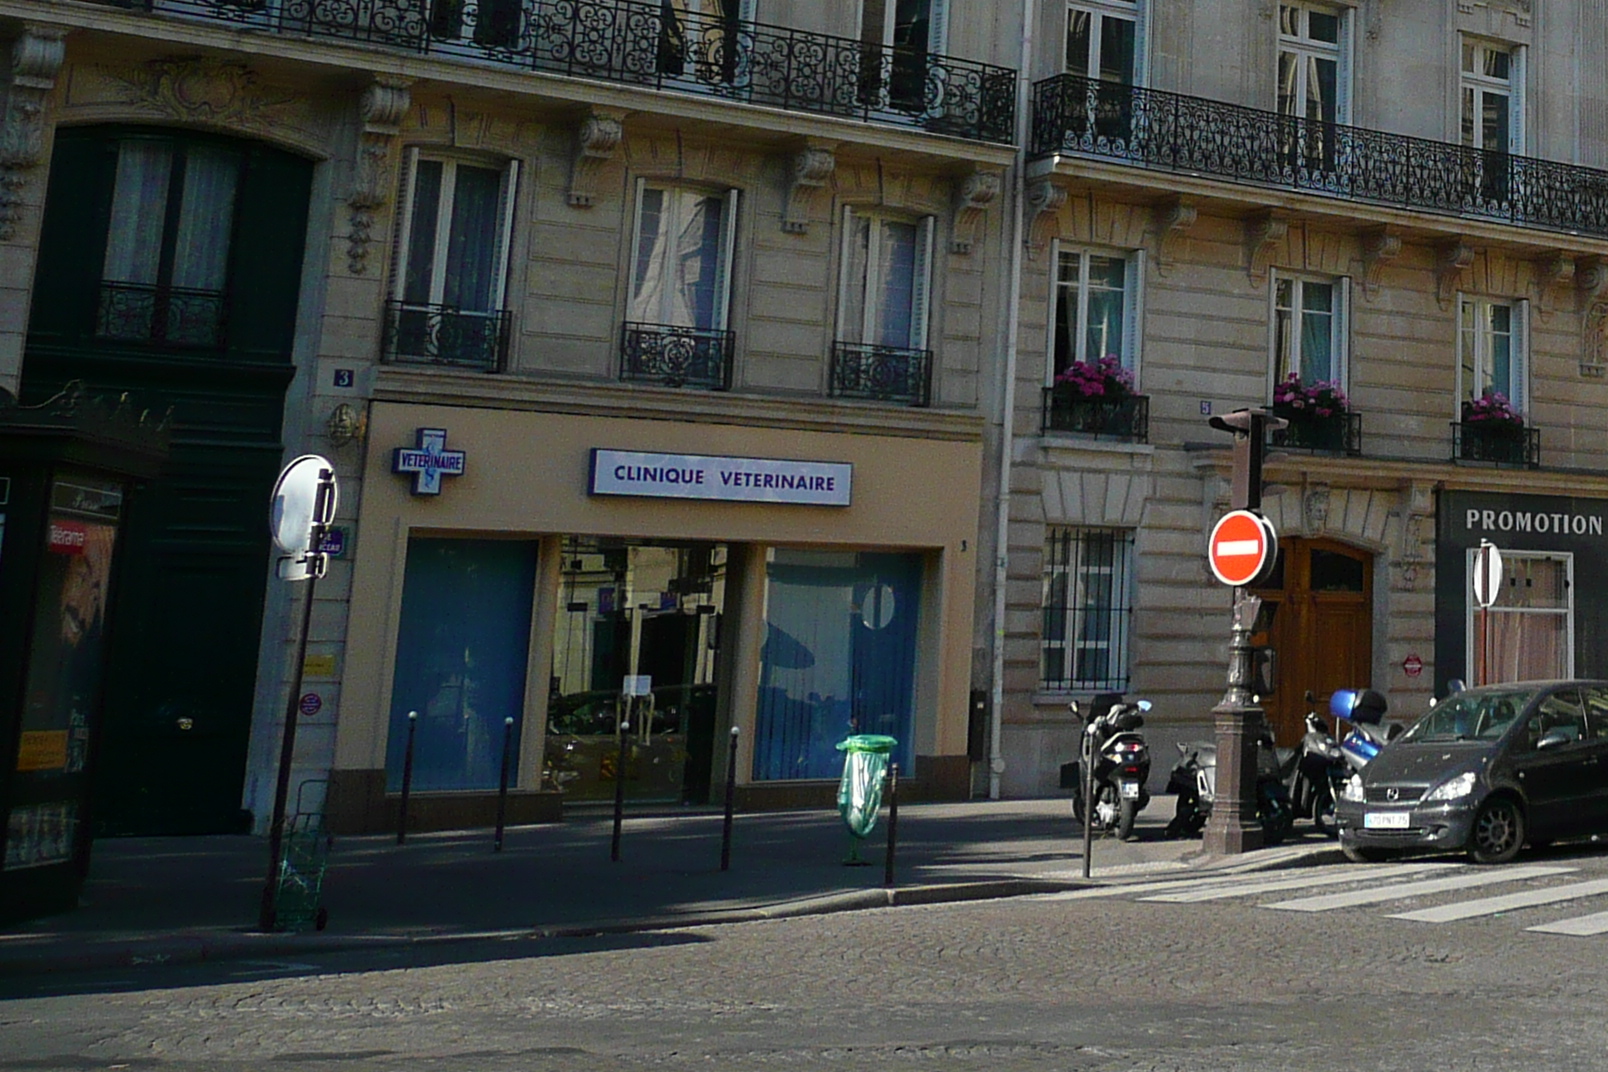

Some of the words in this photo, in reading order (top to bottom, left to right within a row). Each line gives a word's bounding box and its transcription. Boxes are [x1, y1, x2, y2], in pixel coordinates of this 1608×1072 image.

[338, 370, 349, 386] 3
[401, 452, 462, 471] VETERINAIRE
[614, 465, 704, 485] CLINIQUE
[720, 471, 835, 491] VETERINAIRE
[1466, 509, 1603, 536] PROMOTION
